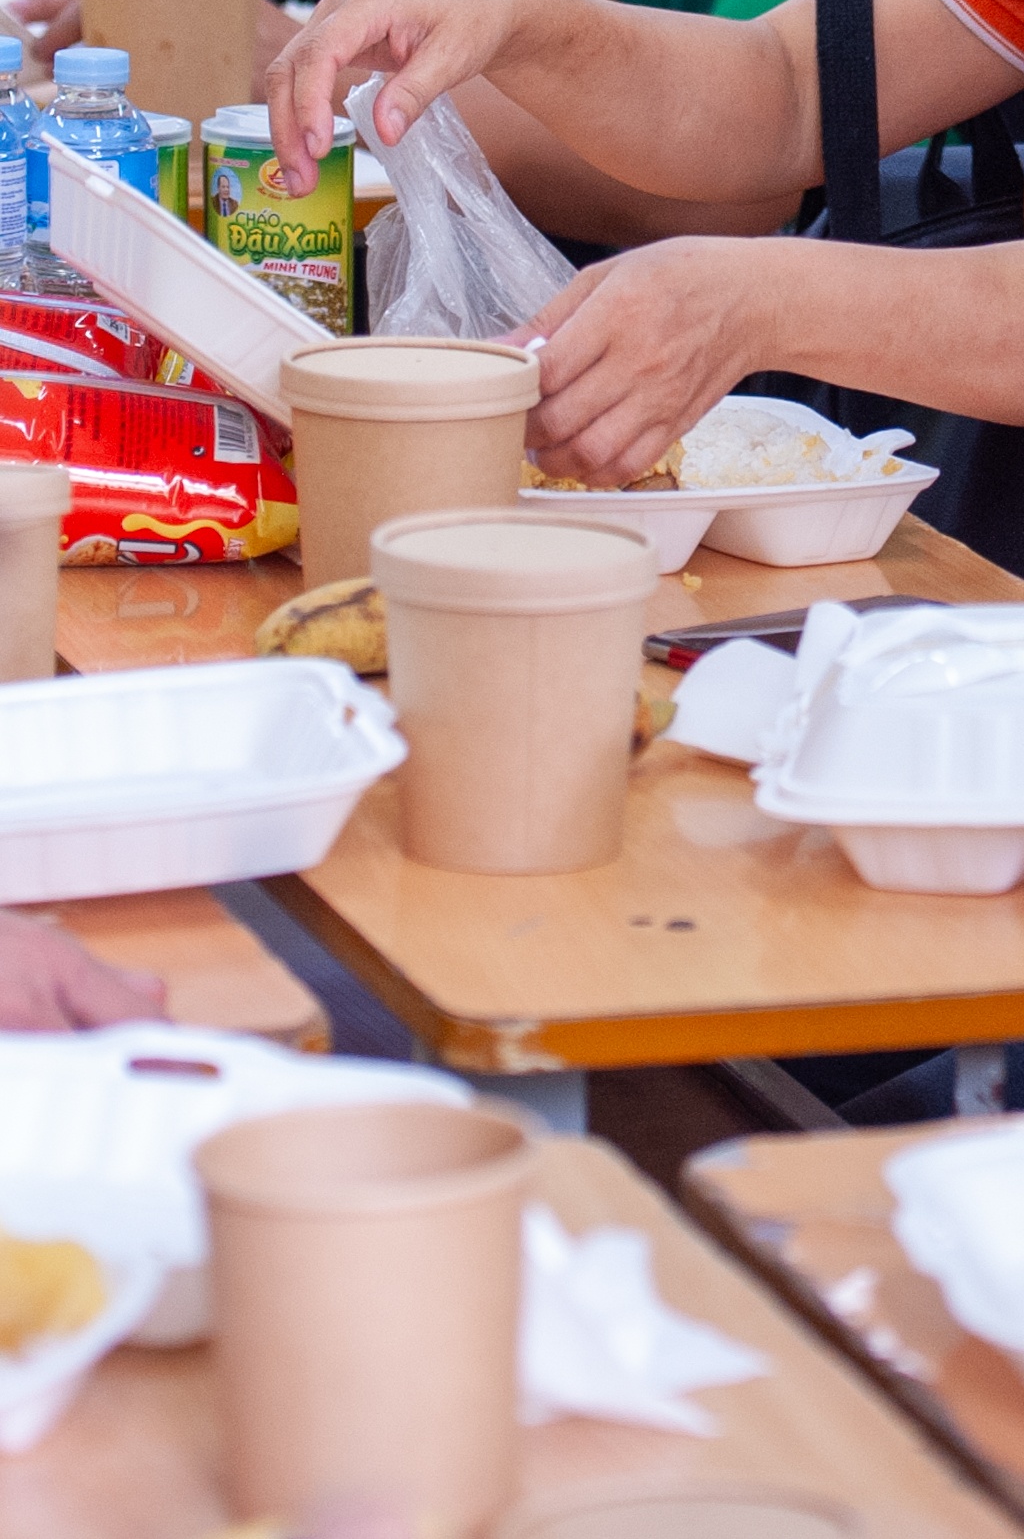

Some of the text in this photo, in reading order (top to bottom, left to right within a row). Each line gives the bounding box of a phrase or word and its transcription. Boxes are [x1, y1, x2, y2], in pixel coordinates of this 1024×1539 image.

[236, 208, 281, 228] CHÁO
[228, 221, 341, 263] Đậu Xanh
[263, 262, 338, 280] MINH TRUNG
